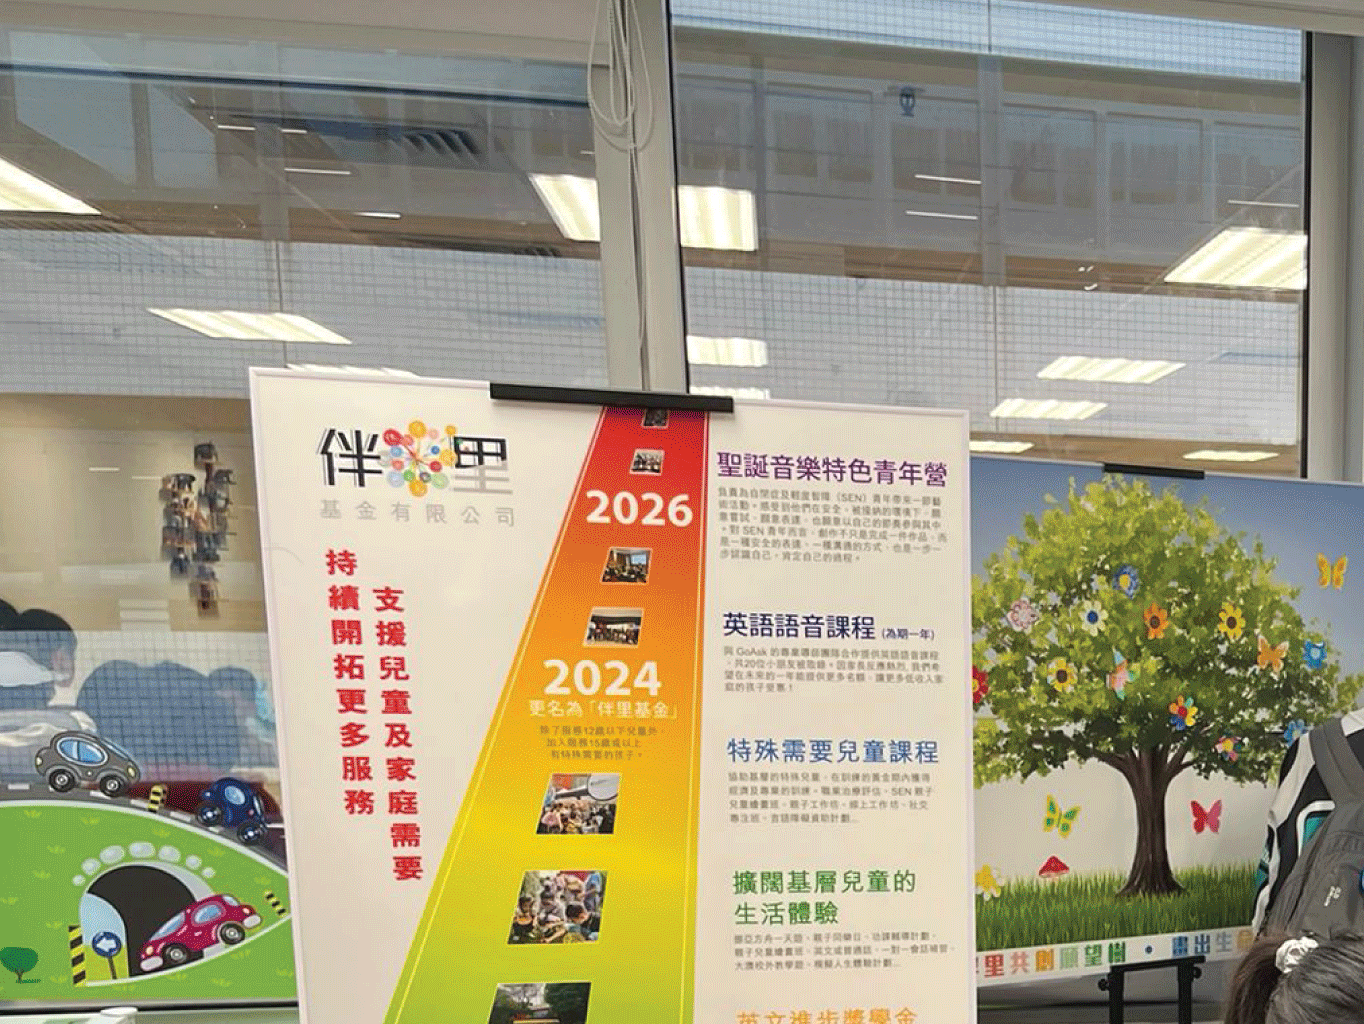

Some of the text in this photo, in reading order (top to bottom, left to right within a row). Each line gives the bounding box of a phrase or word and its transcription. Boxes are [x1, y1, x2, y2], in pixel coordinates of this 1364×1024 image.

[716, 452, 948, 488] 聖誕音樂特色青年營
[319, 499, 515, 528] 基金有限公司
[585, 489, 694, 527] 2026
[742, 526, 764, 536] SEN
[723, 611, 876, 640] 英語語音課程
[325, 548, 375, 817] 持續開拓更多服務
[542, 659, 662, 696] 2024
[372, 586, 424, 882] 支援兒童及家庭需要
[726, 738, 940, 764] 特殊需要兒童課程
[732, 869, 917, 895] 擴闊基層兒童的
[734, 901, 839, 926] 生活體驗
